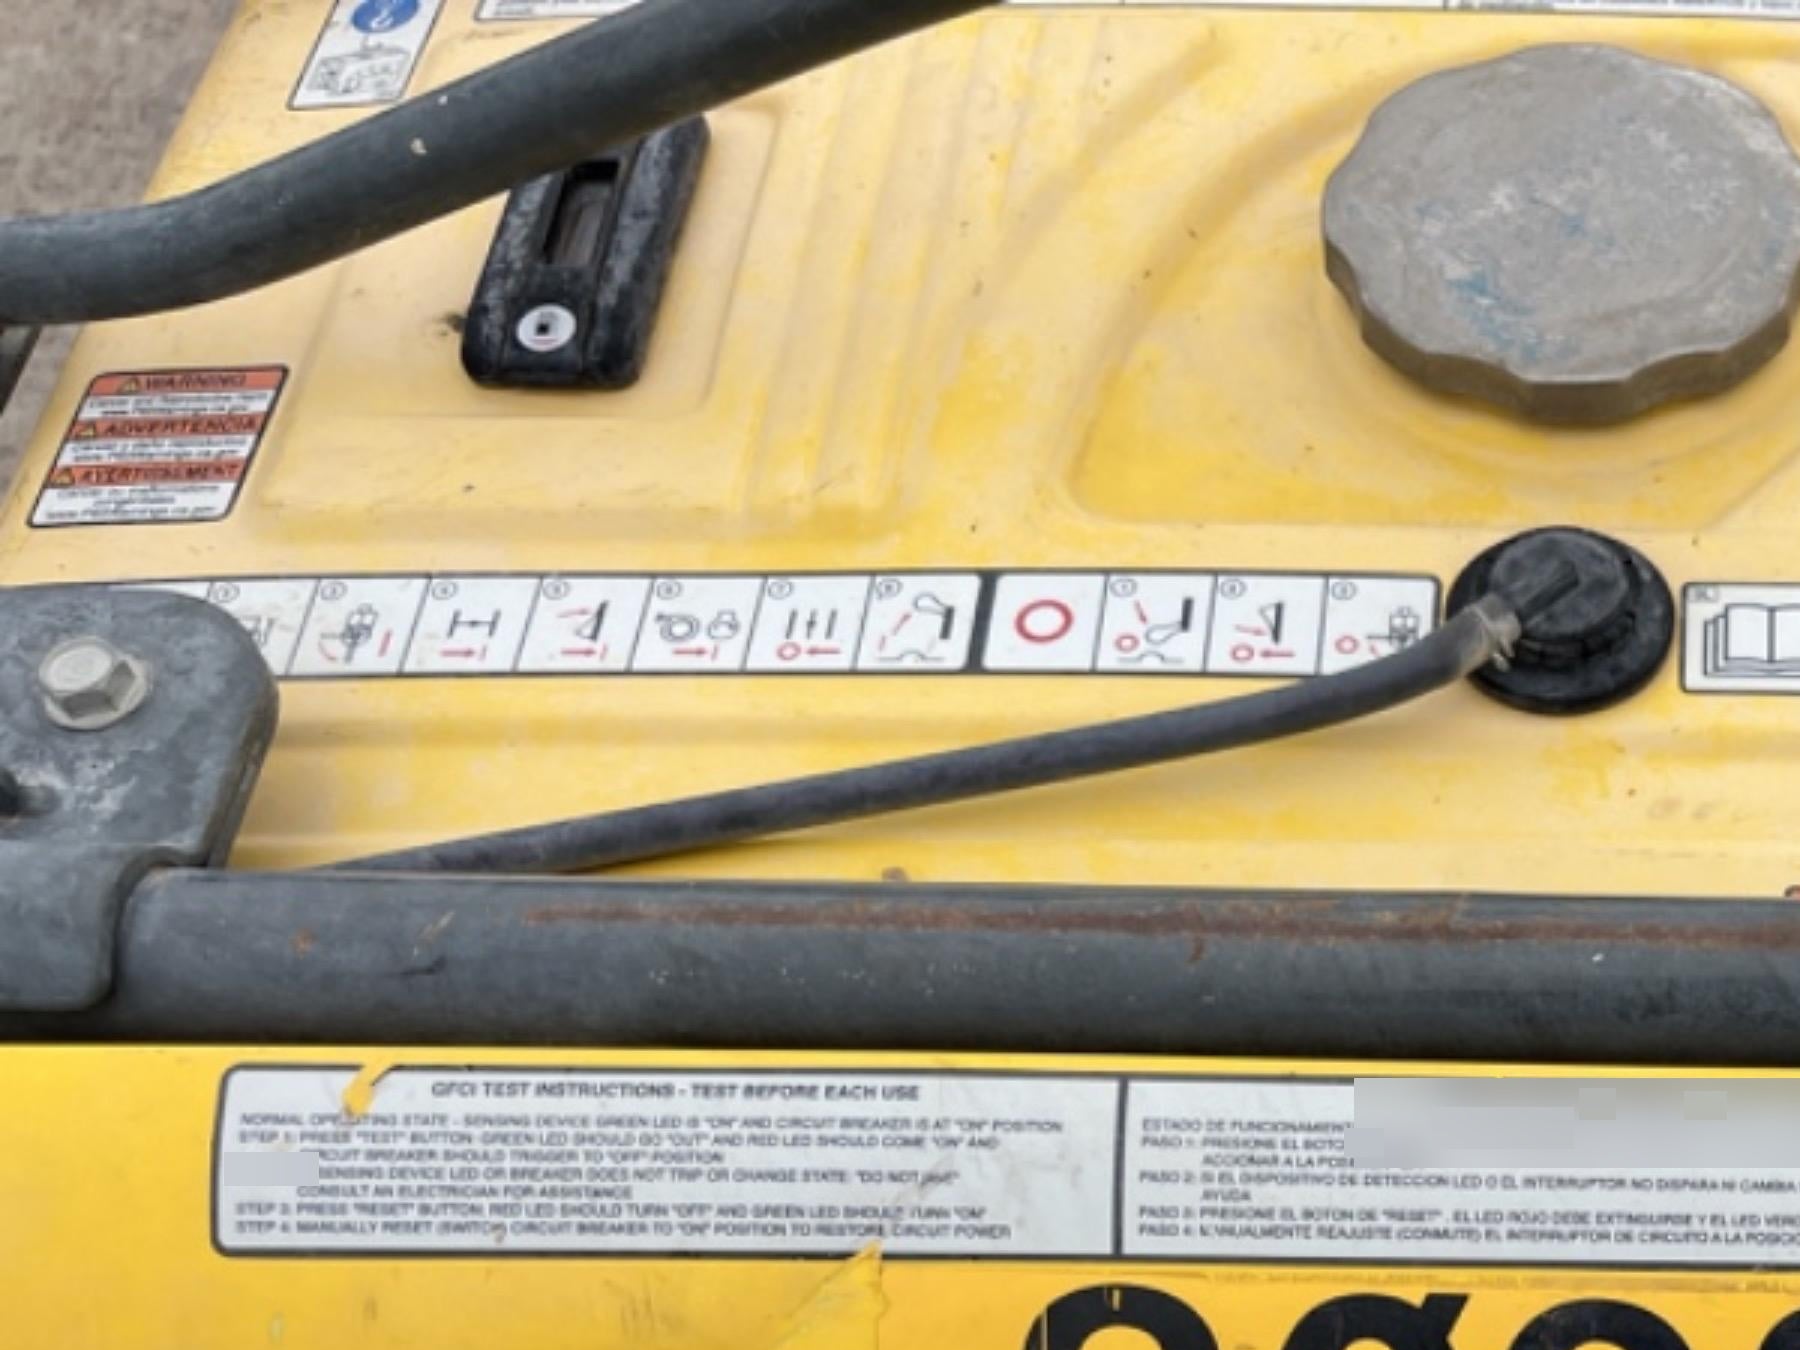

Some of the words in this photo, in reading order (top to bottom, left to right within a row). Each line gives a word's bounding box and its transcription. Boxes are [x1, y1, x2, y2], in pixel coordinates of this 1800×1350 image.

[432, 1082, 477, 1097] GFCI
[483, 1082, 530, 1097] TEST
[534, 1083, 675, 1098] INSTRUCTIONS
[692, 1084, 738, 1099] TEST
[743, 1084, 818, 1099] BEFORE
[824, 1085, 877, 1100] EACH
[882, 1085, 920, 1100] USE
